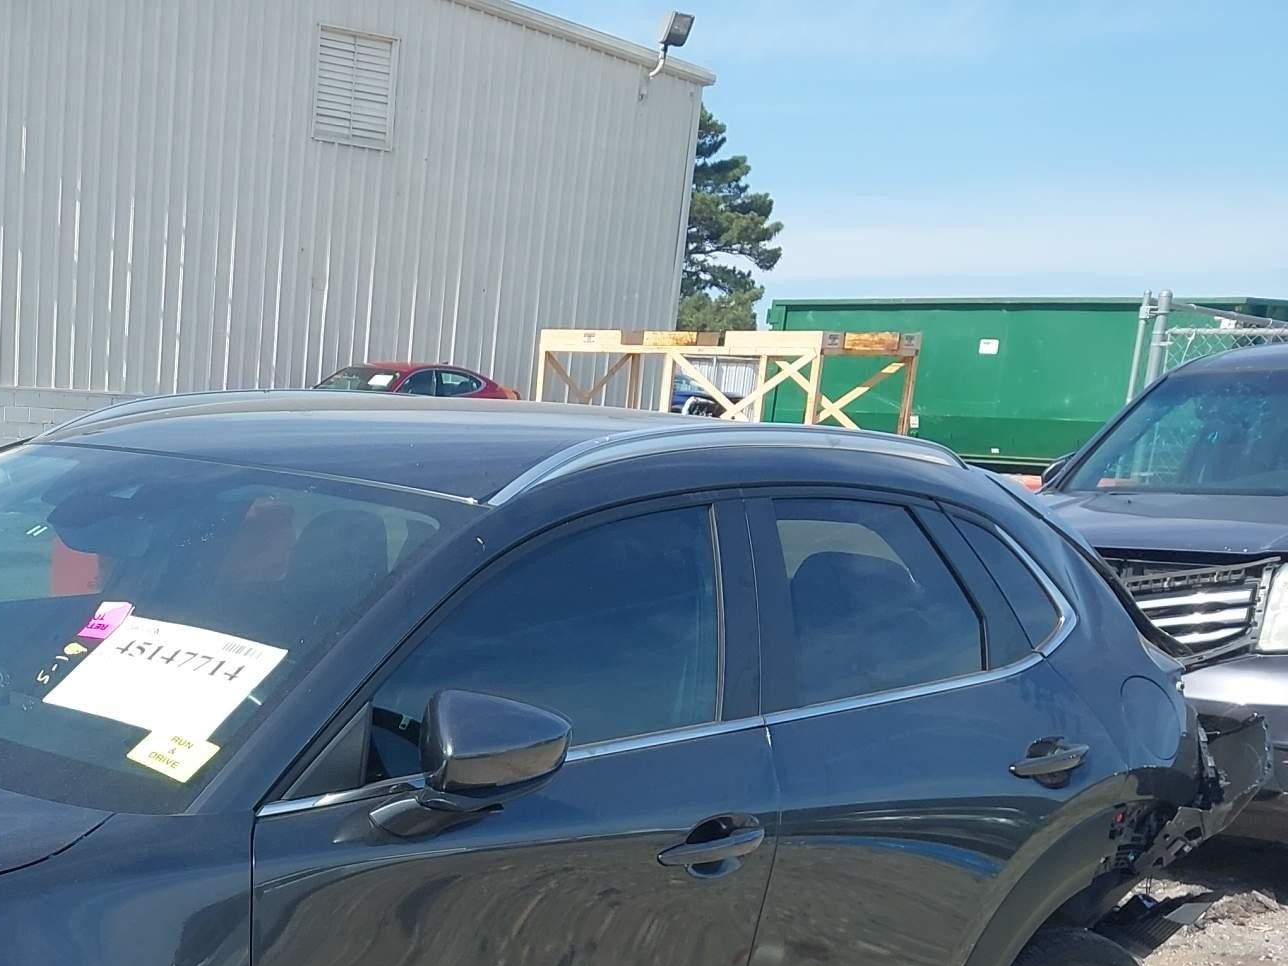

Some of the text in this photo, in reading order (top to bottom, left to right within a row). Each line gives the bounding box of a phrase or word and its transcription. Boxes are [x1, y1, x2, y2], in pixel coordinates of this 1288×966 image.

[115, 639, 246, 681] 45147714
[170, 735, 194, 750] RUN
[148, 751, 180, 769] DRIVE
